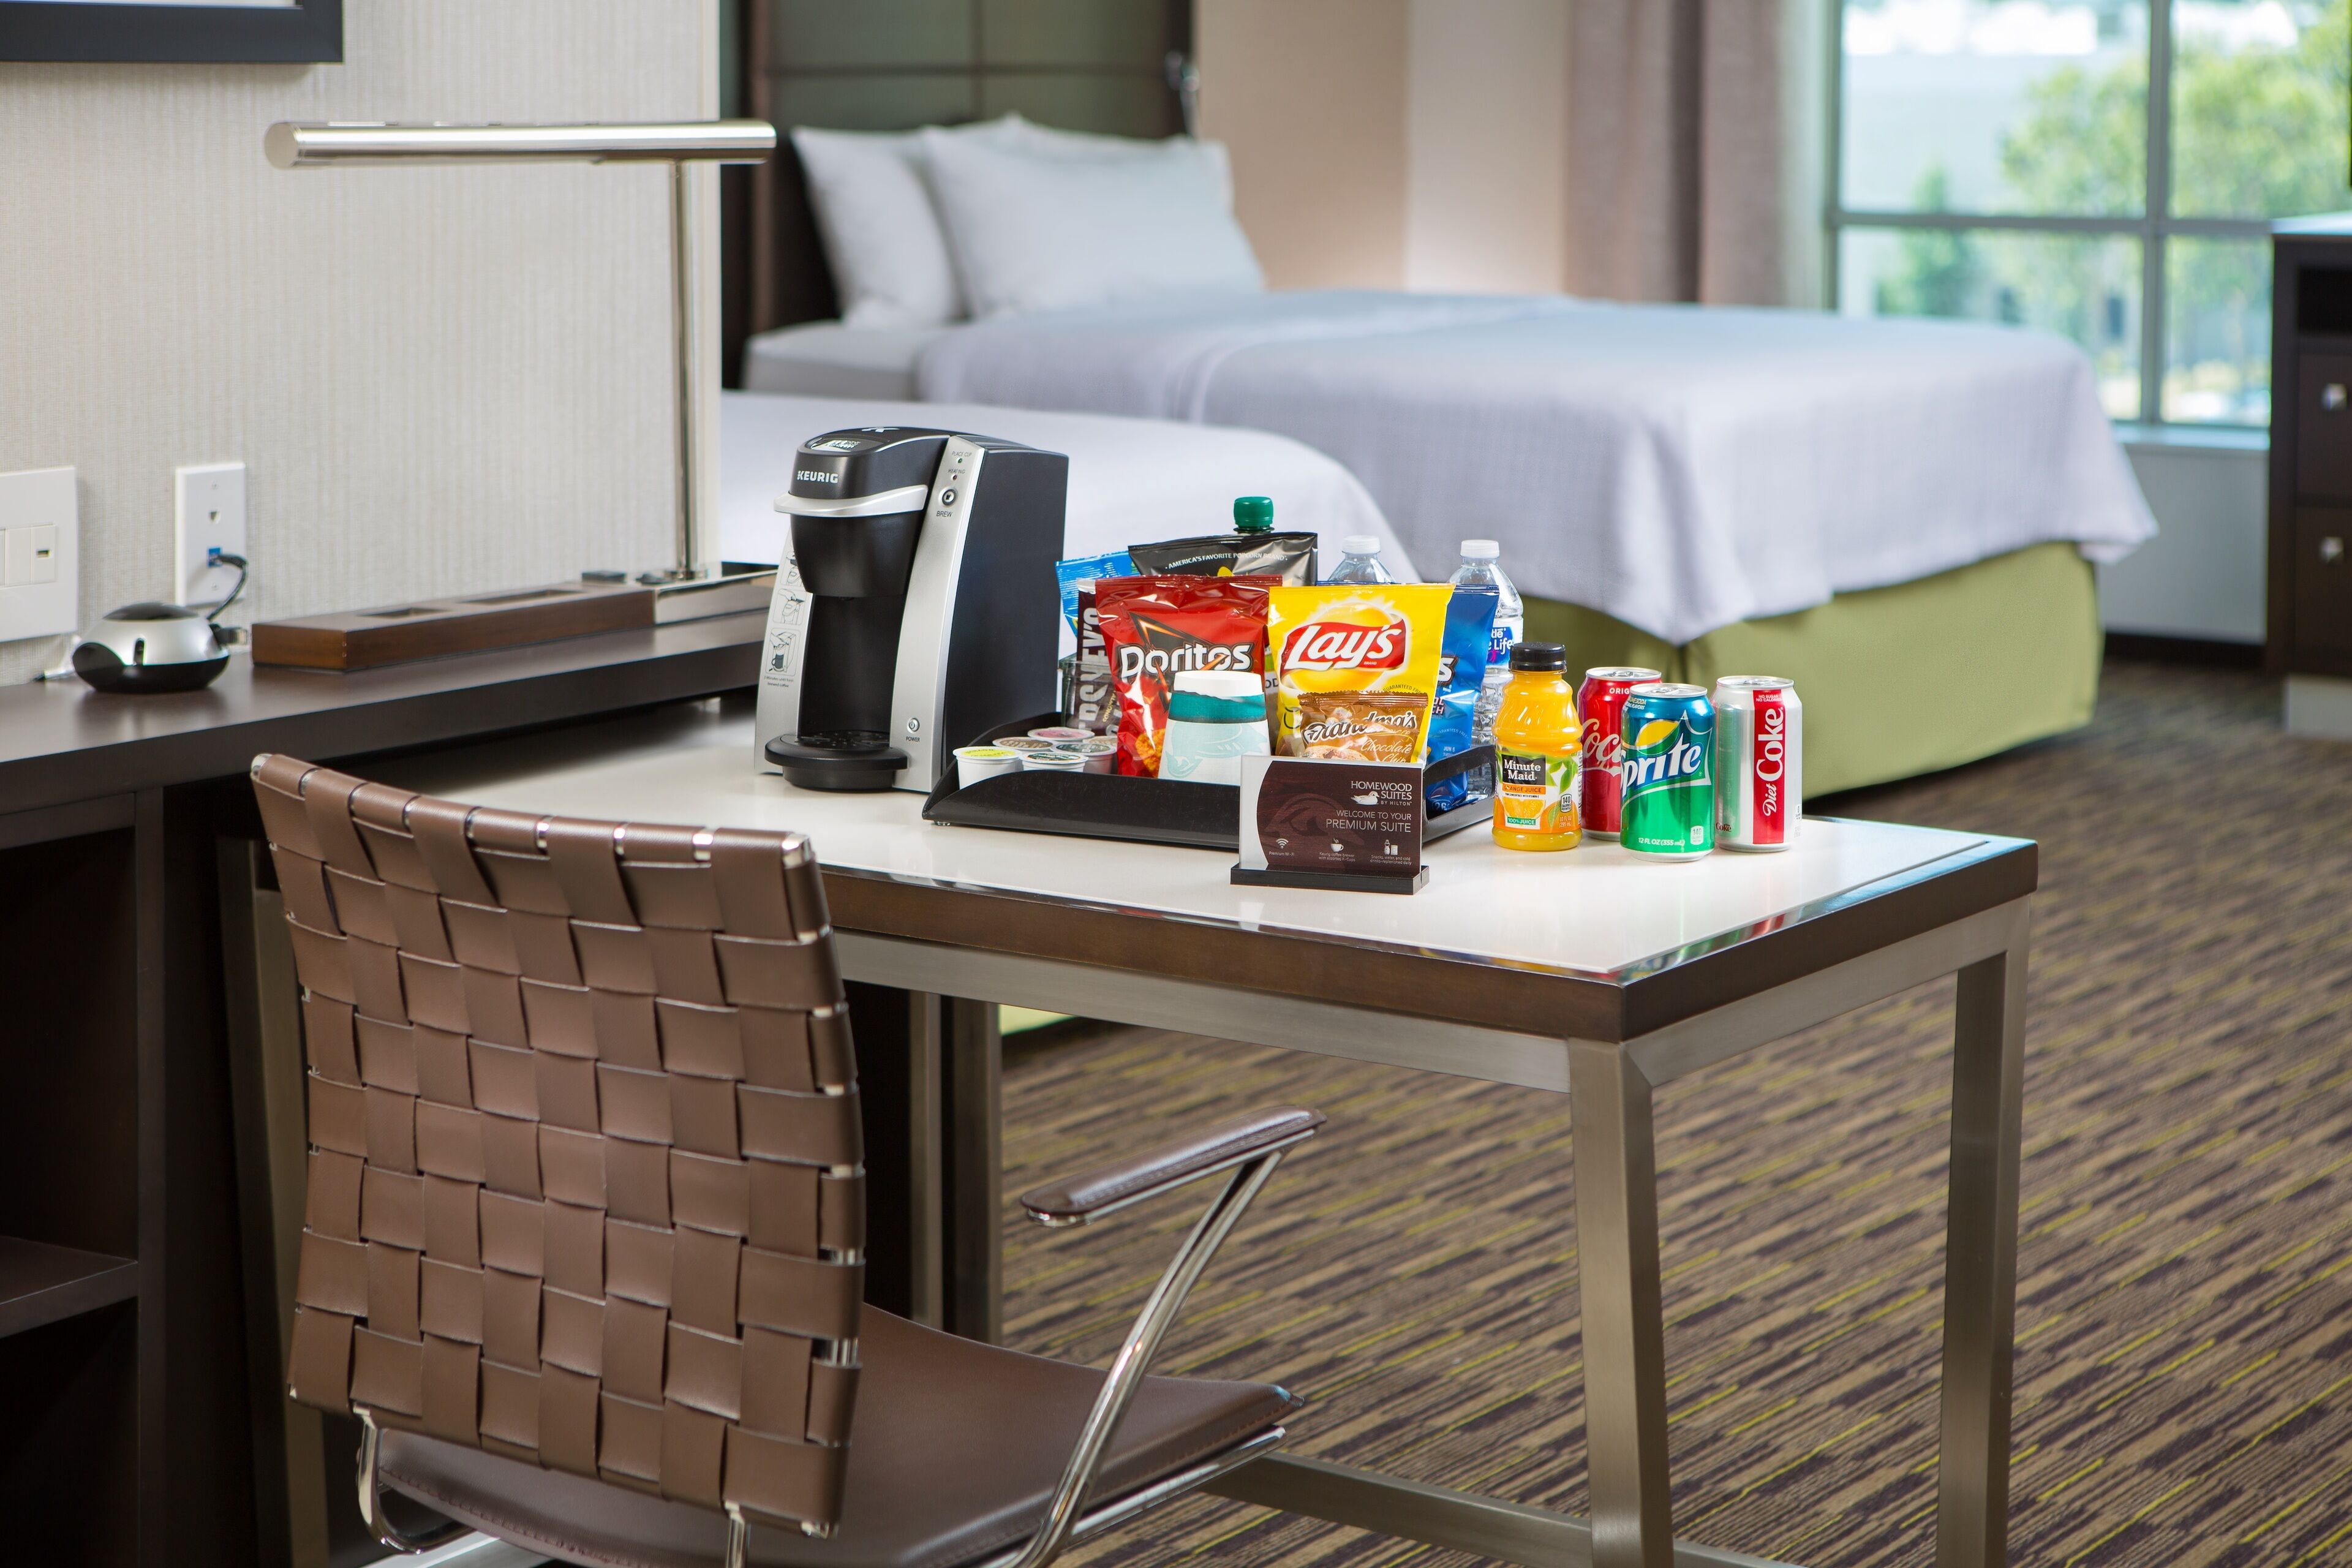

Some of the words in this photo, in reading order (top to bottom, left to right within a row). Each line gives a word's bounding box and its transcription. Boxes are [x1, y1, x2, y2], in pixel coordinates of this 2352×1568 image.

[797, 470, 839, 484] KEURIG
[1169, 556, 1202, 569] AMERICA'S
[1202, 552, 1232, 561] FAVORITE
[1283, 624, 1402, 671] Lay's
[1494, 637, 1513, 655] Life
[1119, 642, 1253, 684] Doritos
[1360, 738, 1412, 754] Chocolate
[1755, 707, 1784, 782] Coke
[1504, 759, 1542, 771] Minute
[1507, 769, 1536, 781] Maid
[1351, 780, 1412, 791] HOMEWOOD
[1381, 791, 1412, 801] SUITES
[1762, 783, 1777, 816] Diet
[1336, 810, 1376, 819] WELCOME
[1326, 818, 1377, 831] PREMIUM
[1380, 821, 1411, 832] SUITE
